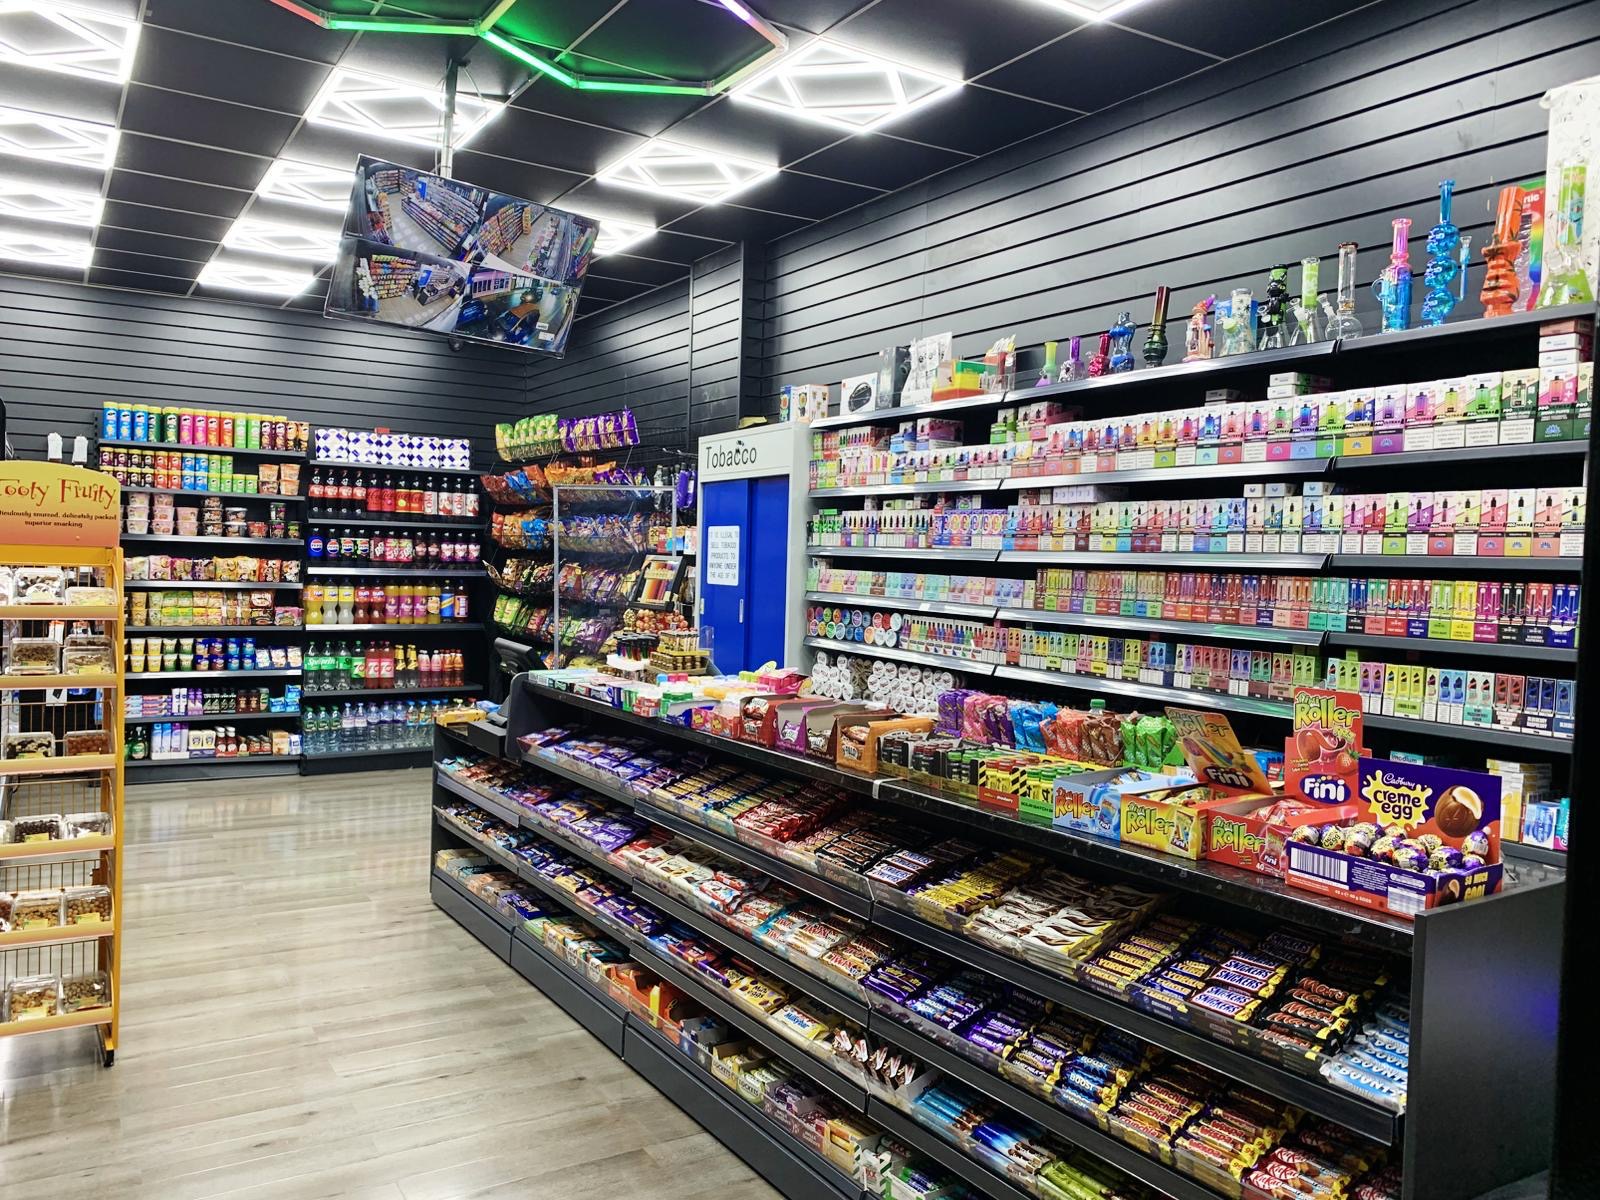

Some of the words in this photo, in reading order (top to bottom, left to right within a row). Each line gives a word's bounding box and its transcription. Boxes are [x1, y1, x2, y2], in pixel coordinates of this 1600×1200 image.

[705, 444, 757, 469] Tobacco
[57, 477, 117, 510] Fruity
[24, 519, 52, 528] superior
[94, 513, 117, 521] packed
[1294, 697, 1360, 731] Roller
[1170, 713, 1230, 738] Roller
[1206, 767, 1250, 788] Fini
[1382, 772, 1416, 790] Cadbury
[1304, 777, 1345, 802] Fini
[1373, 788, 1422, 808] creme
[1054, 792, 1100, 820] Roller
[1380, 803, 1413, 821] egg
[1125, 808, 1175, 835] Roller
[1210, 822, 1266, 853] Roller
[1110, 950, 1146, 966] YORKIE
[1120, 942, 1156, 959] YORKIE
[1099, 958, 1135, 975] YORKIE
[1224, 960, 1270, 979] SNICKERS
[1168, 971, 1206, 990] YORKIE
[1216, 970, 1261, 990] SNICKERS
[1299, 976, 1350, 1001] Mars
[1196, 994, 1238, 1014] SNICKERS
[1209, 987, 1248, 1004] SNICKERS
[784, 1010, 810, 1030] Milkybar
[1266, 1012, 1321, 1030] Mars
[1280, 1001, 1336, 1024] Mars
[1080, 1055, 1110, 1071] BOOST
[738, 1078, 759, 1097] LOCKETS
[1070, 1072, 1095, 1091] BOOST
[1140, 1092, 1180, 1116] crunchie
[1148, 1083, 1188, 1105] crunchie
[1128, 1100, 1170, 1122] crunchie
[1250, 1170, 1283, 1190] KitKat
[1266, 1162, 1300, 1180] KitKat
